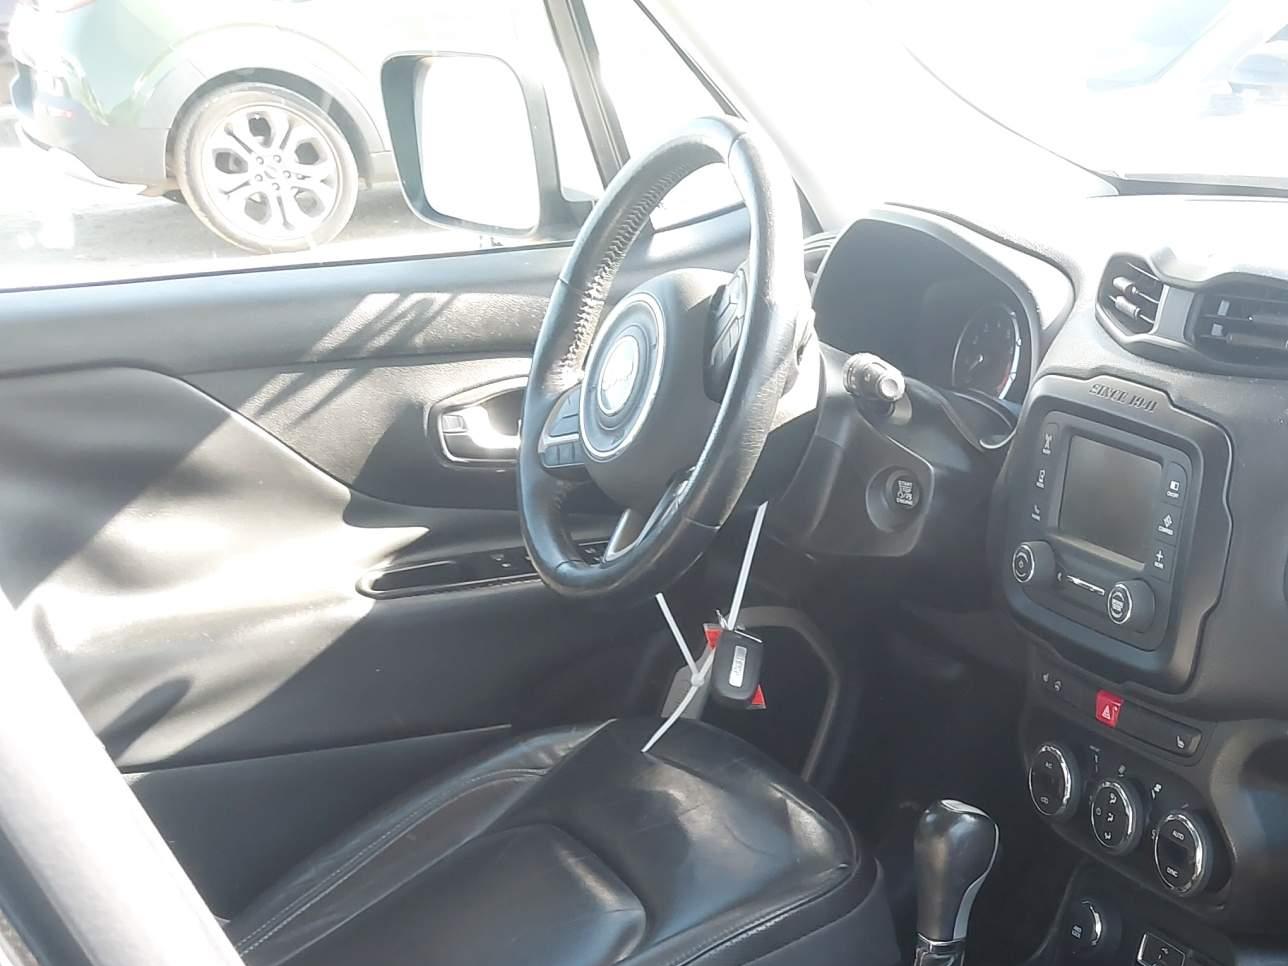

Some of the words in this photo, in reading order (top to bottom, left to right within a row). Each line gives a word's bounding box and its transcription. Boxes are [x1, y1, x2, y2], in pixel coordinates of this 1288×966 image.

[1089, 384, 1128, 404] SINCE
[1129, 395, 1158, 412] 1941
[1172, 830, 1185, 841] AUTO
